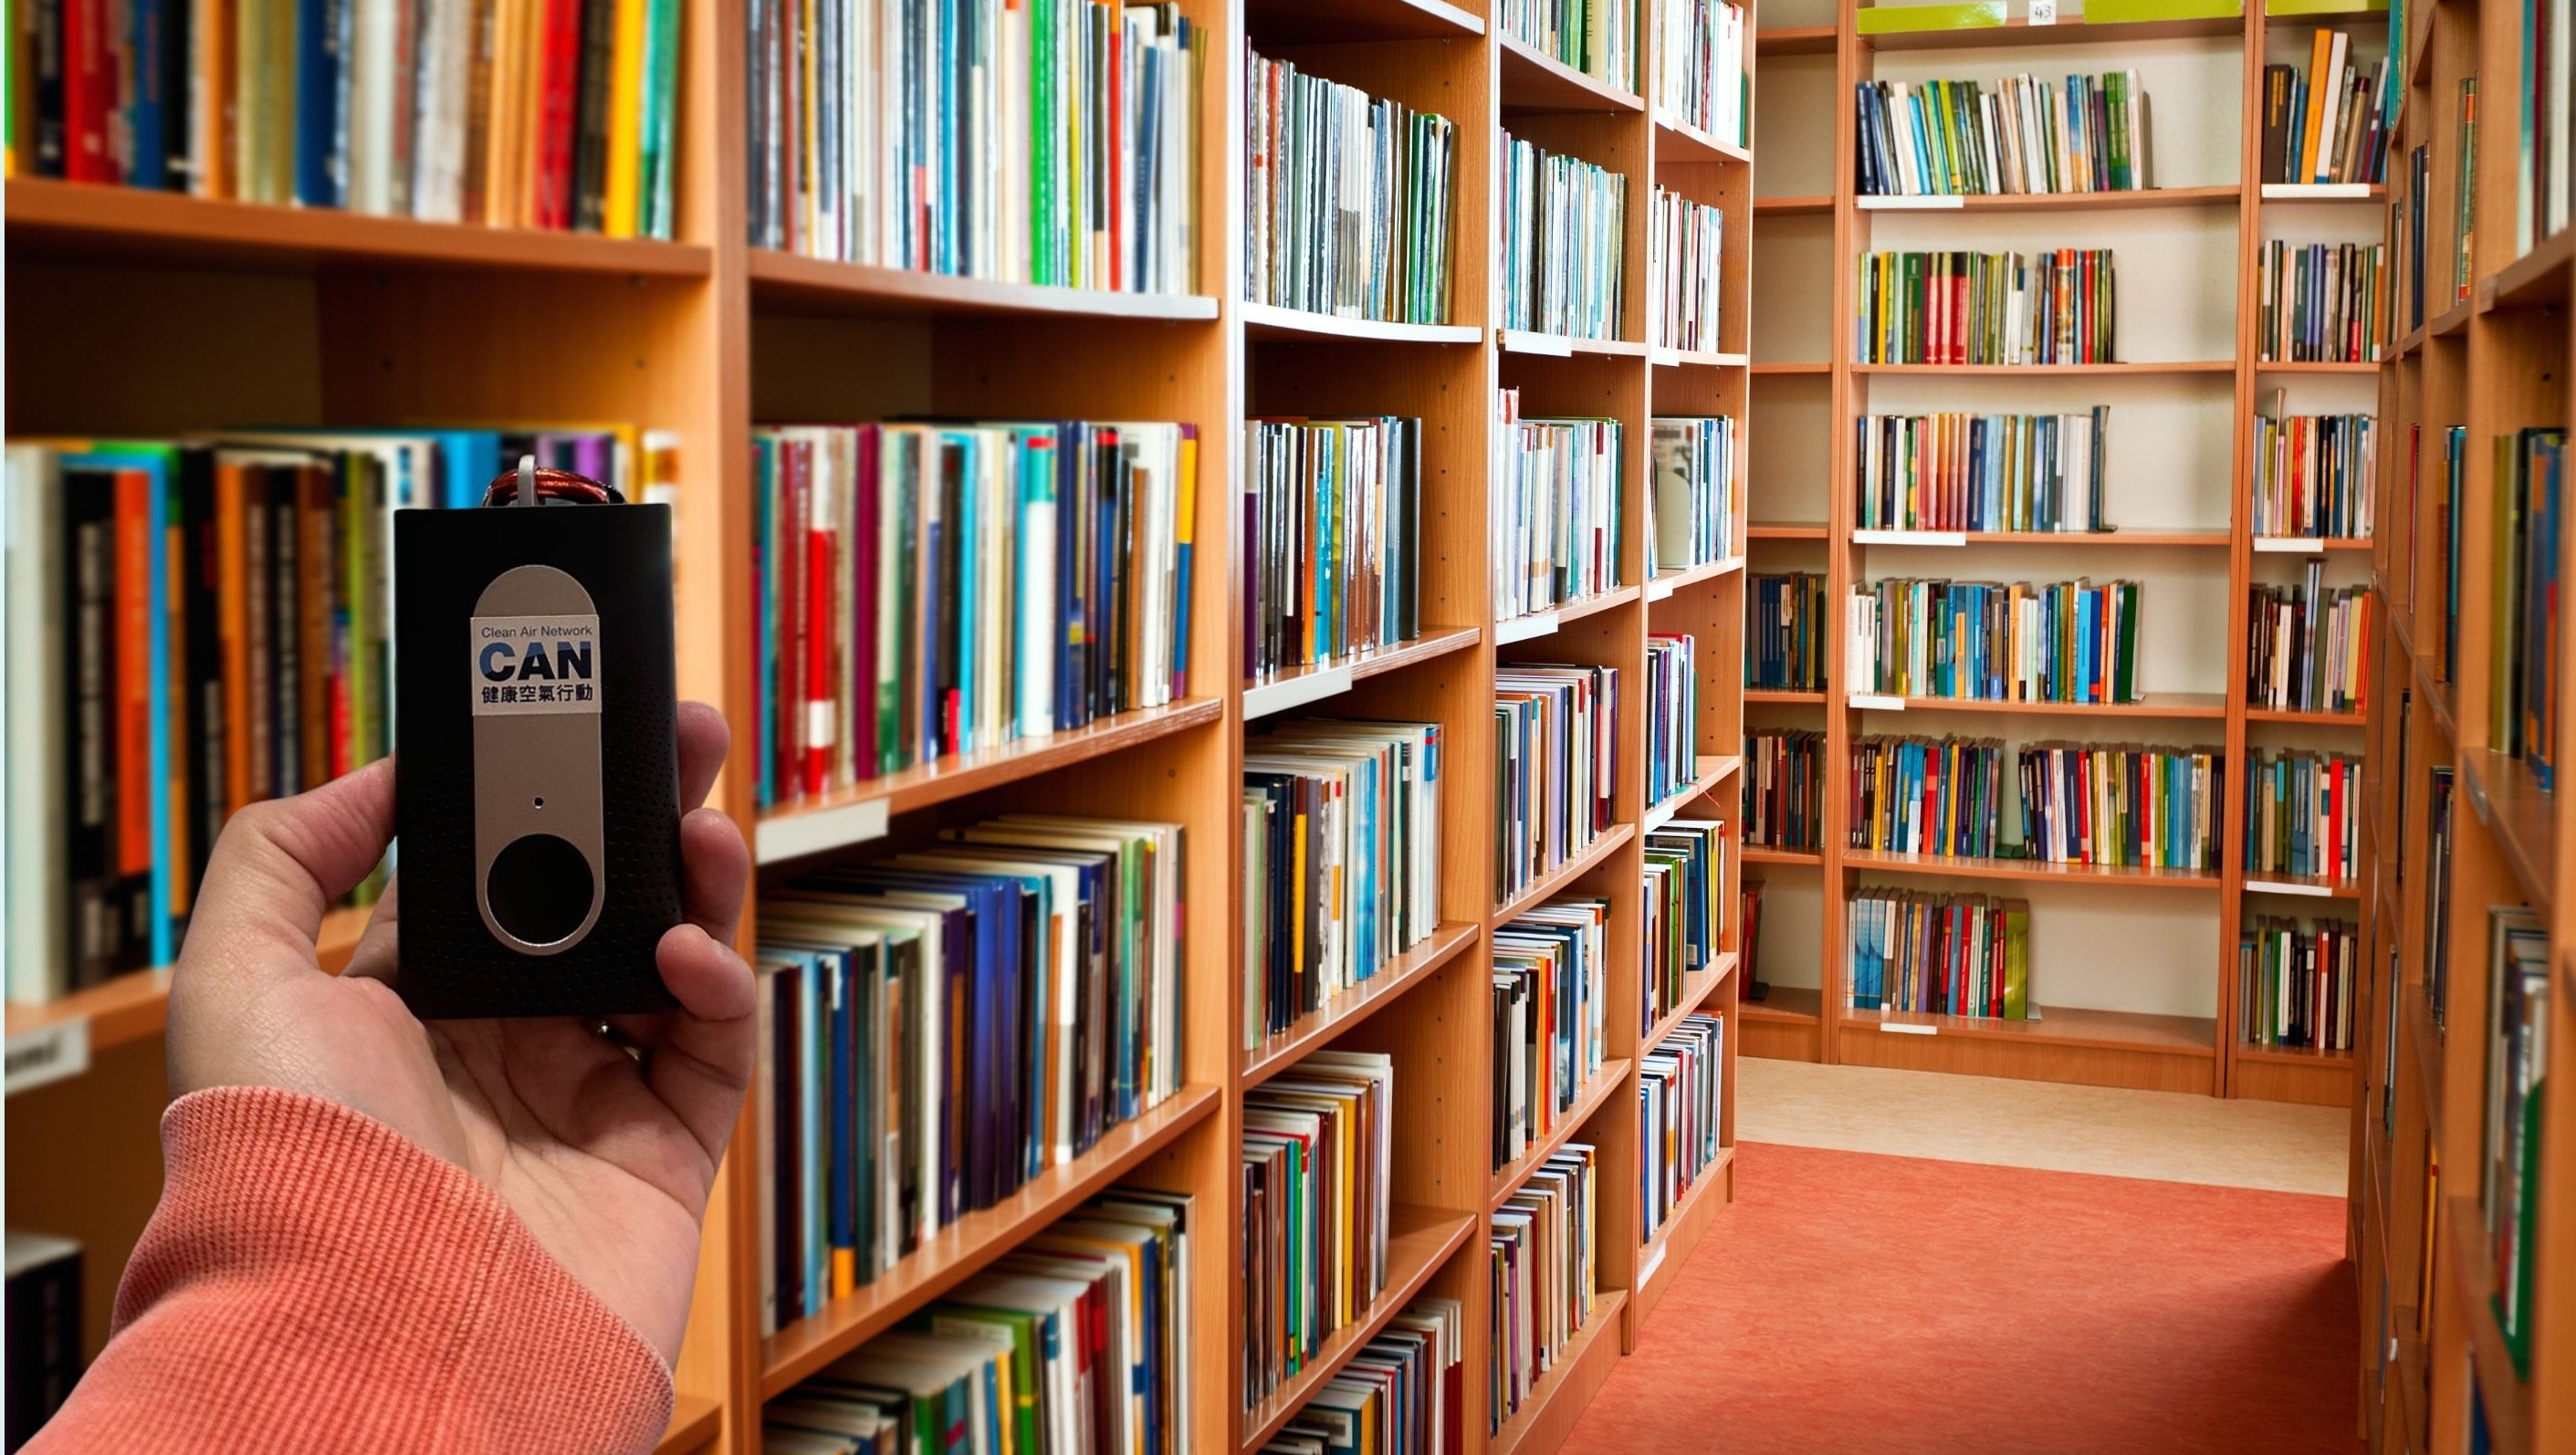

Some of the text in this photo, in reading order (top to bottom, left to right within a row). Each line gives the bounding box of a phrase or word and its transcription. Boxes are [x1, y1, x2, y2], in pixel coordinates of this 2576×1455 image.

[481, 625, 592, 638] Clean Air Network
[479, 641, 592, 682] CAN
[481, 684, 593, 704] 健康空氣行動
